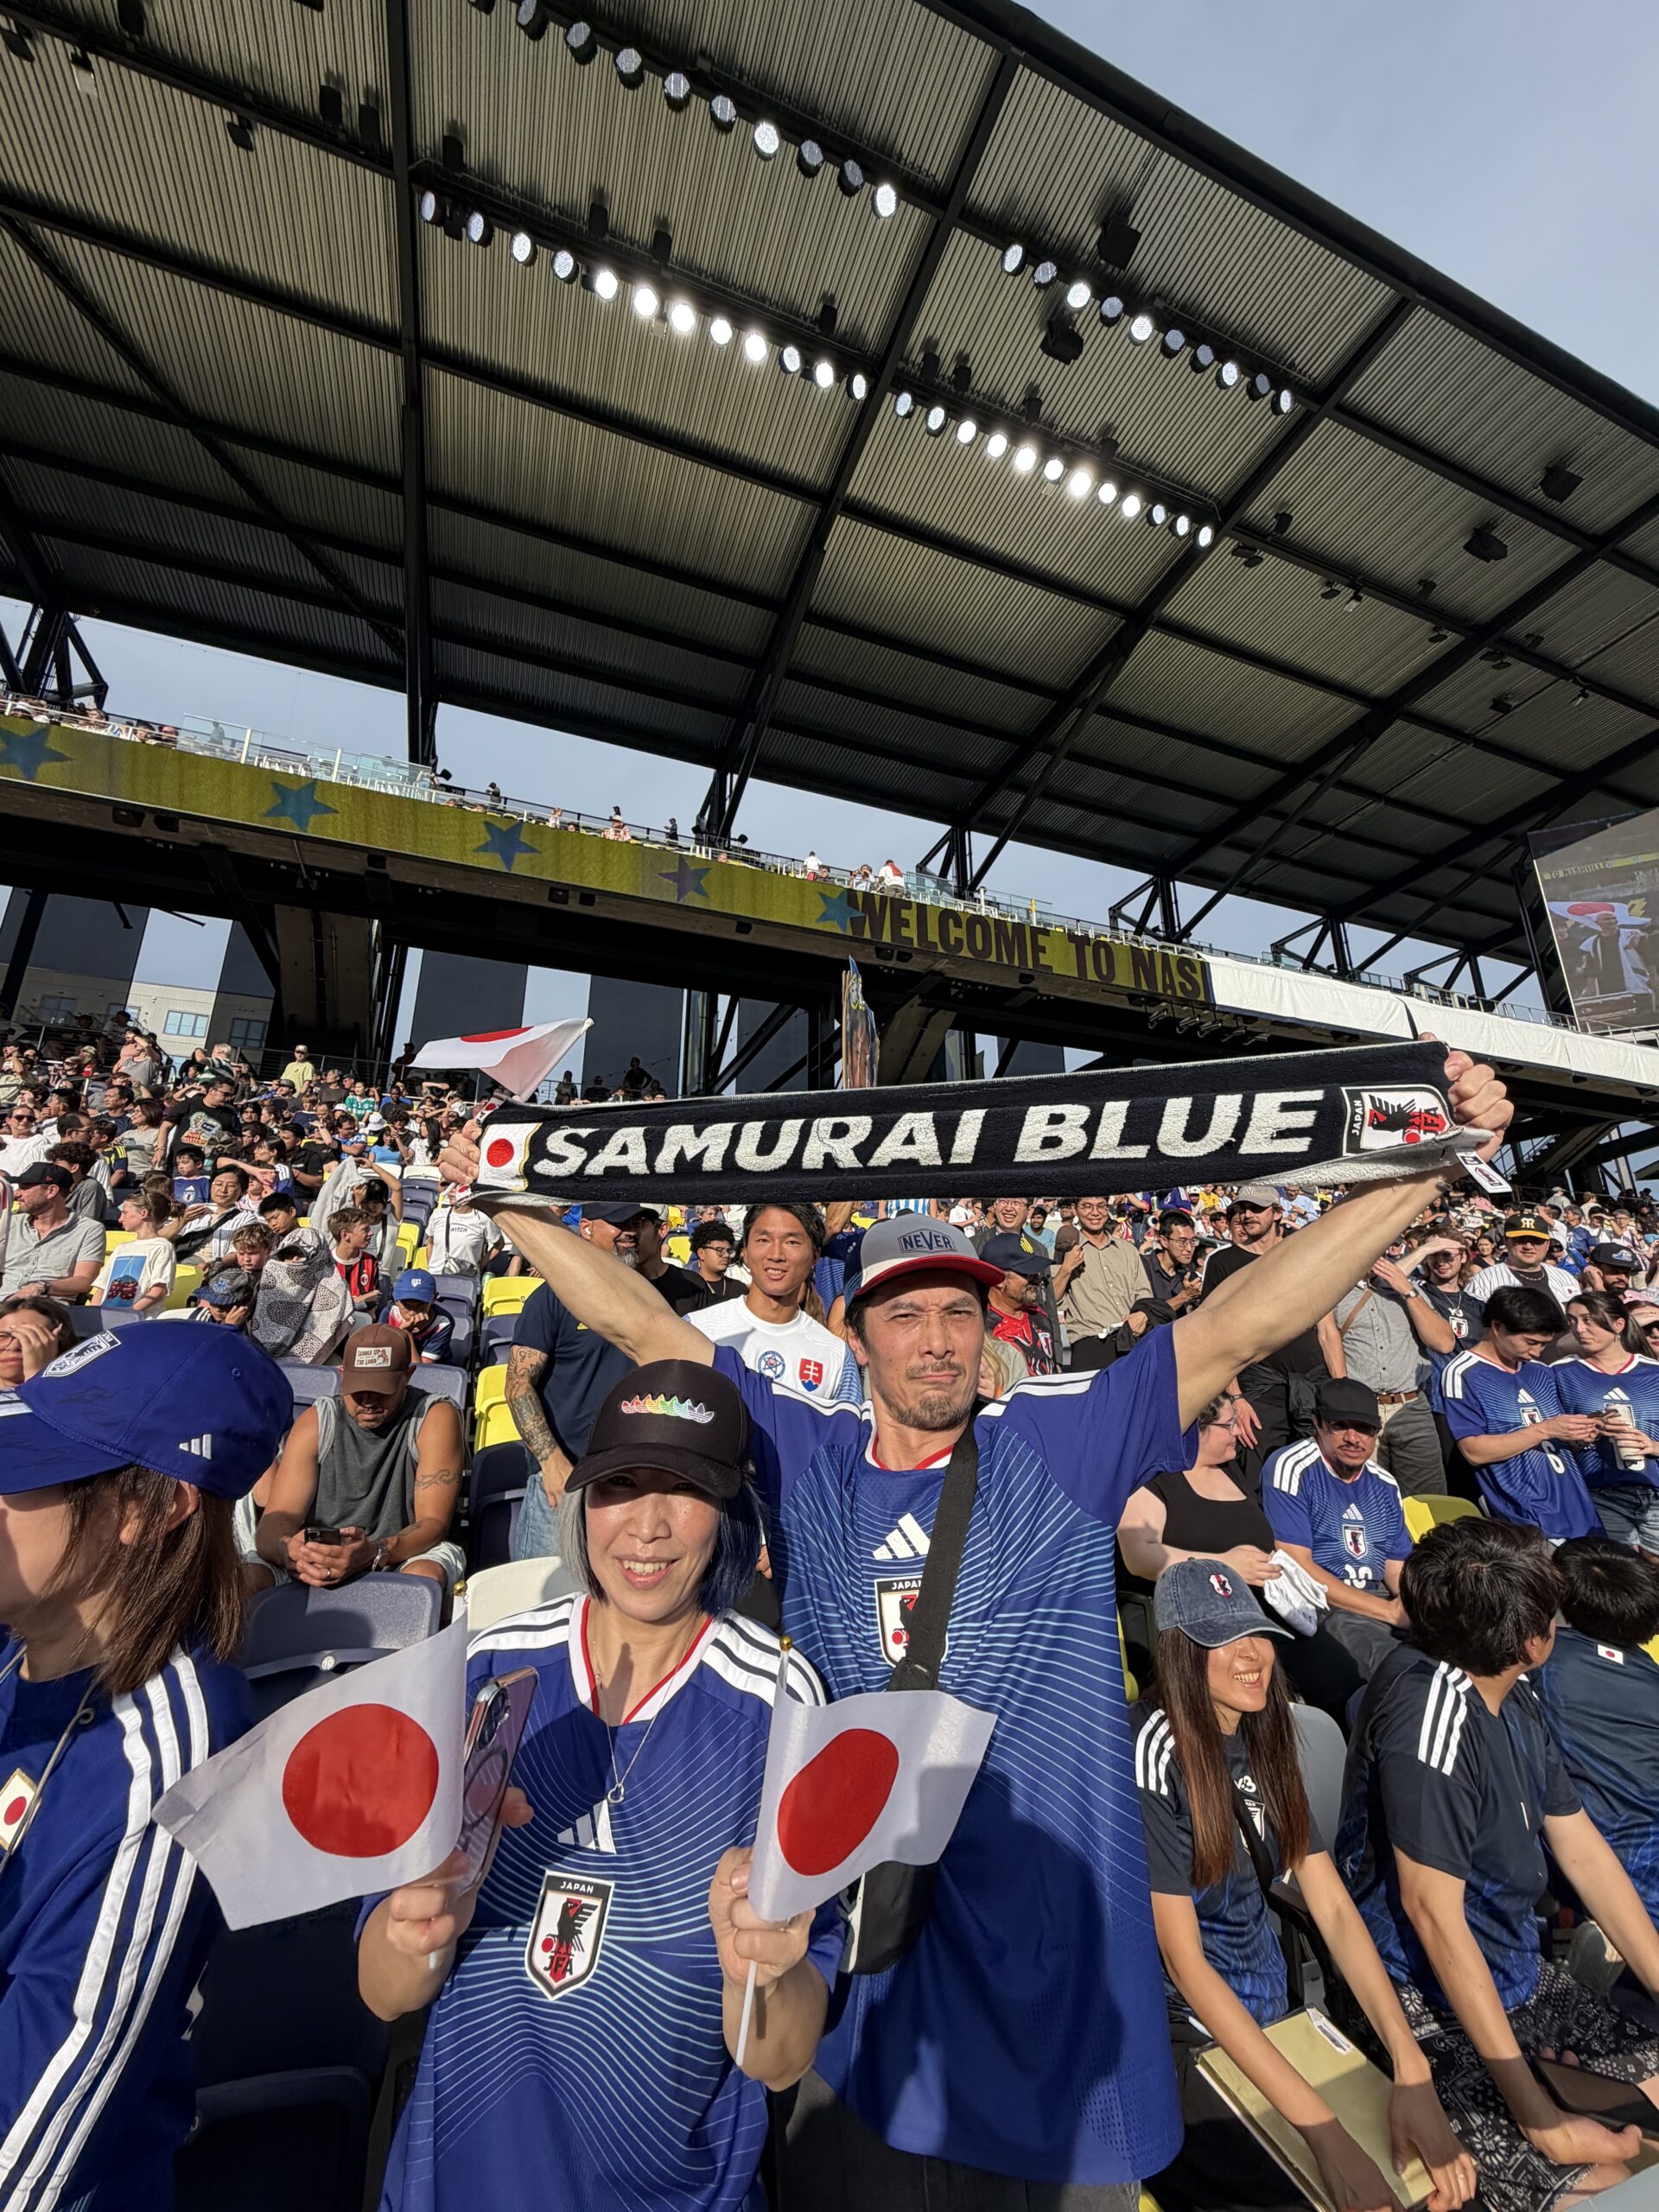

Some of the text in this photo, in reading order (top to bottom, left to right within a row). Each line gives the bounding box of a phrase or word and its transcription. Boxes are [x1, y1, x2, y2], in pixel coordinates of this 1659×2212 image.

[847, 889, 1053, 971] WELCOME
[1067, 931, 1116, 983] TO
[1351, 1100, 1363, 1136] JAPAN
[1422, 1106, 1440, 1136] JFA
[533, 1090, 1324, 1177] SAMURAI BLUE
[902, 1231, 953, 1250] NEVER
[560, 1881, 594, 1893] JAPAN
[543, 1955, 574, 1976] JFA
